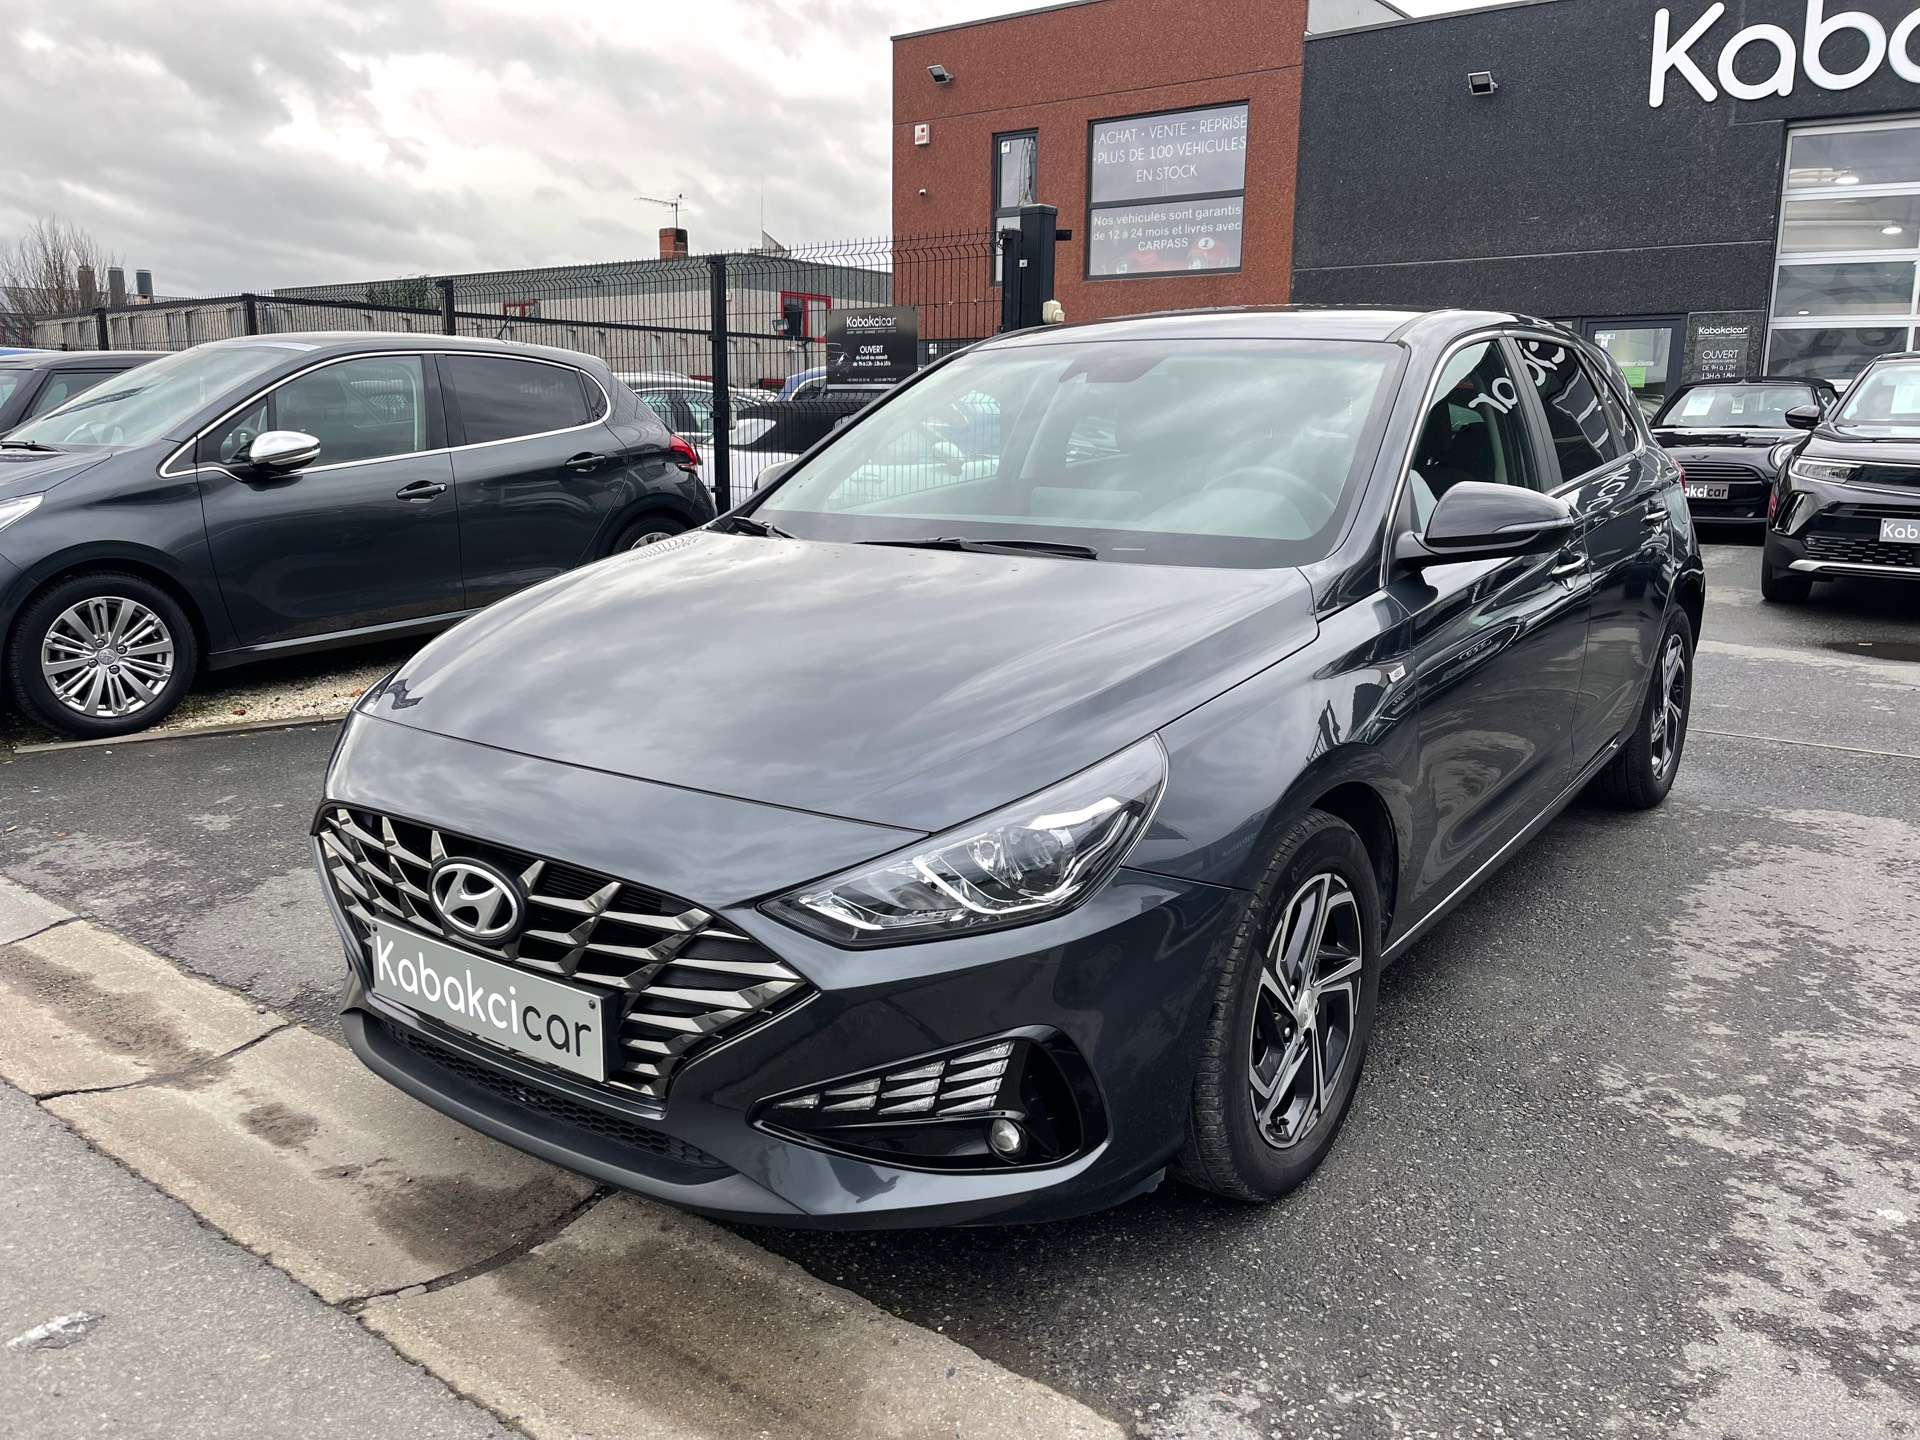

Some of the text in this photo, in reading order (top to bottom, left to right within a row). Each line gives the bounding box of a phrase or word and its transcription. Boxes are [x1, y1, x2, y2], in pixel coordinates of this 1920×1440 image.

[1098, 113, 1247, 145] ACHAT VENTE REPRISE
[1097, 136, 1246, 165] PLUS DE 100 VEHICULES
[1136, 163, 1198, 182] EN STOCK
[1094, 215, 1113, 226] Nos
[1169, 208, 1192, 220] sont
[1195, 204, 1241, 220] garantis
[1093, 230, 1105, 241] de
[1108, 229, 1120, 240] 12
[1130, 227, 1142, 239] 24
[1145, 226, 1169, 237] mois
[1172, 225, 1182, 235] et
[1215, 222, 1241, 231] avec
[1138, 237, 1188, 252] CARPASS
[859, 345, 883, 354] OUVERT
[1702, 349, 1738, 359] OUVERT
[376, 935, 592, 1057] Kabakcicar
